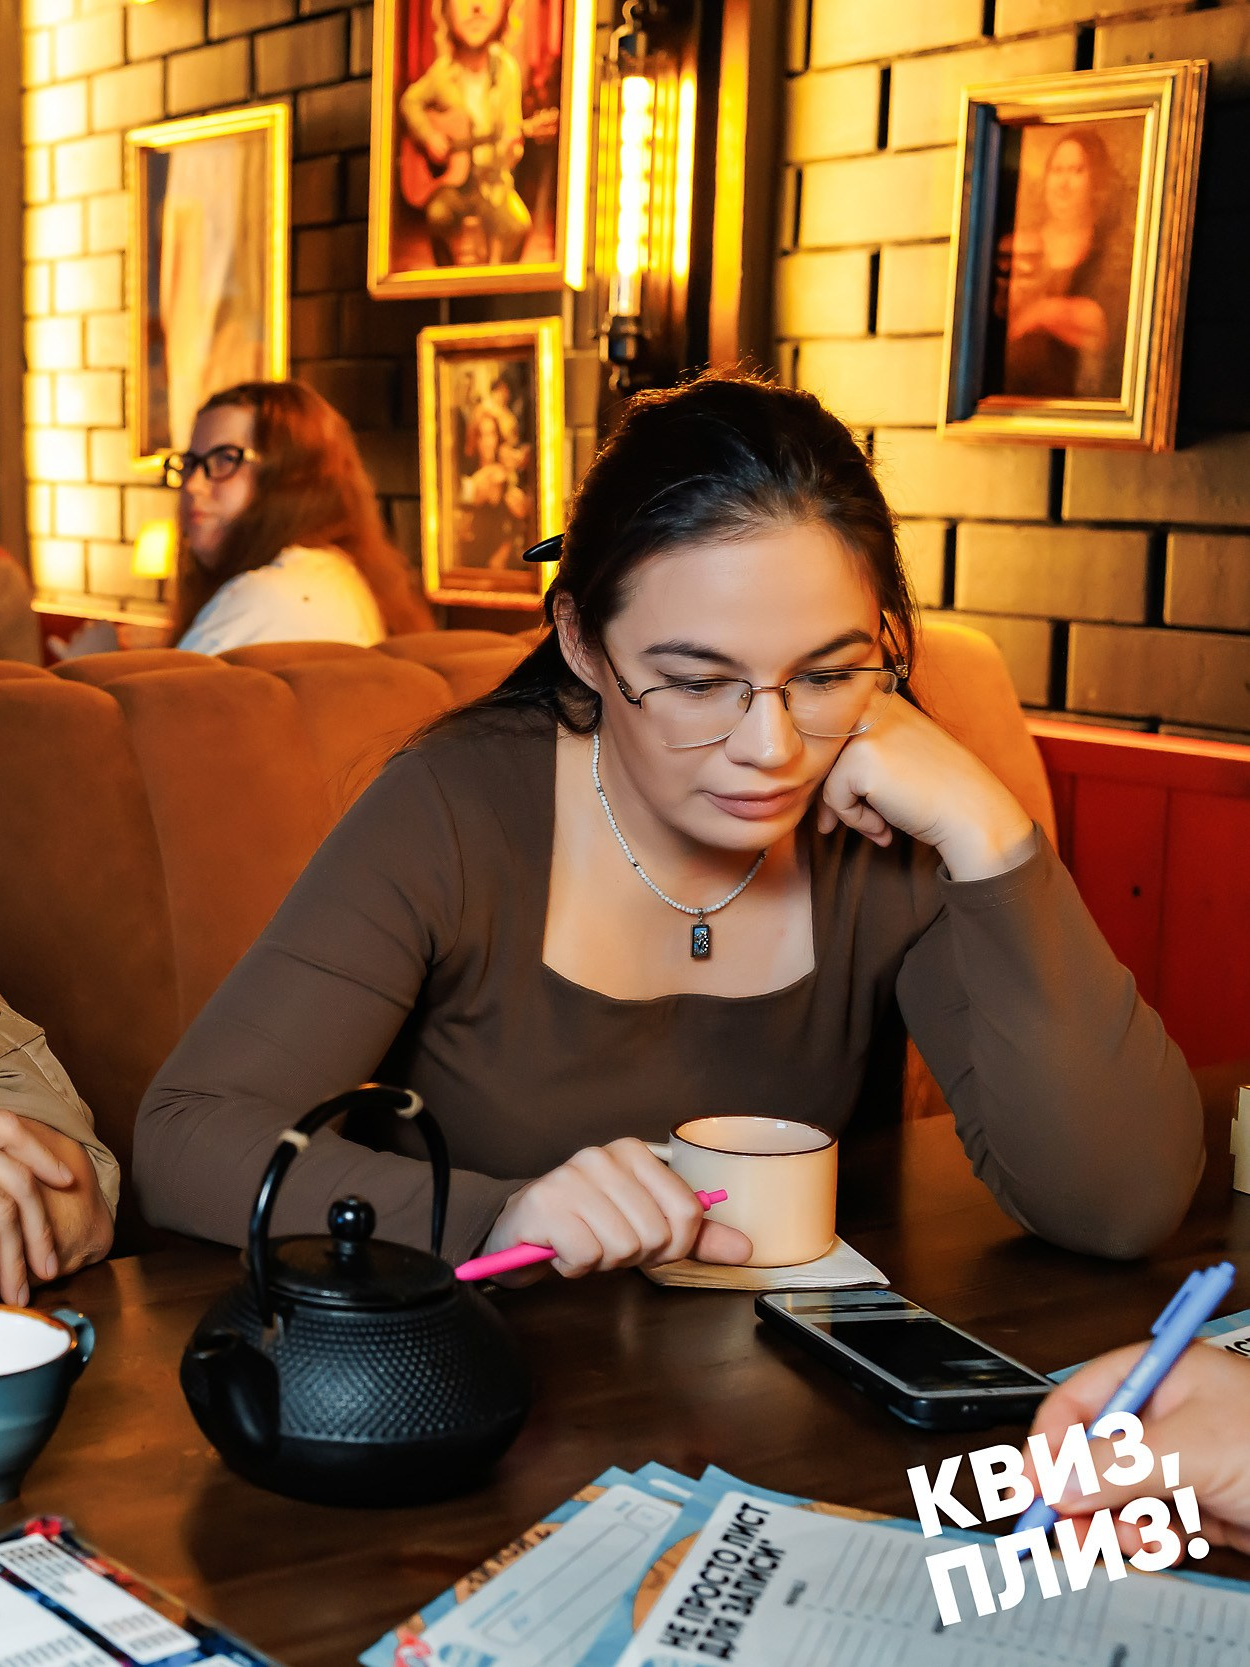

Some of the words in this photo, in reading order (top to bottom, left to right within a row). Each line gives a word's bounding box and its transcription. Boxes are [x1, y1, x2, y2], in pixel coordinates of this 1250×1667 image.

[721, 1502, 771, 1550] ЛИСТ
[676, 1549, 743, 1624] ПРОСТО
[658, 1621, 699, 1650] НЕ
[697, 1617, 745, 1662] ДЛЯ
